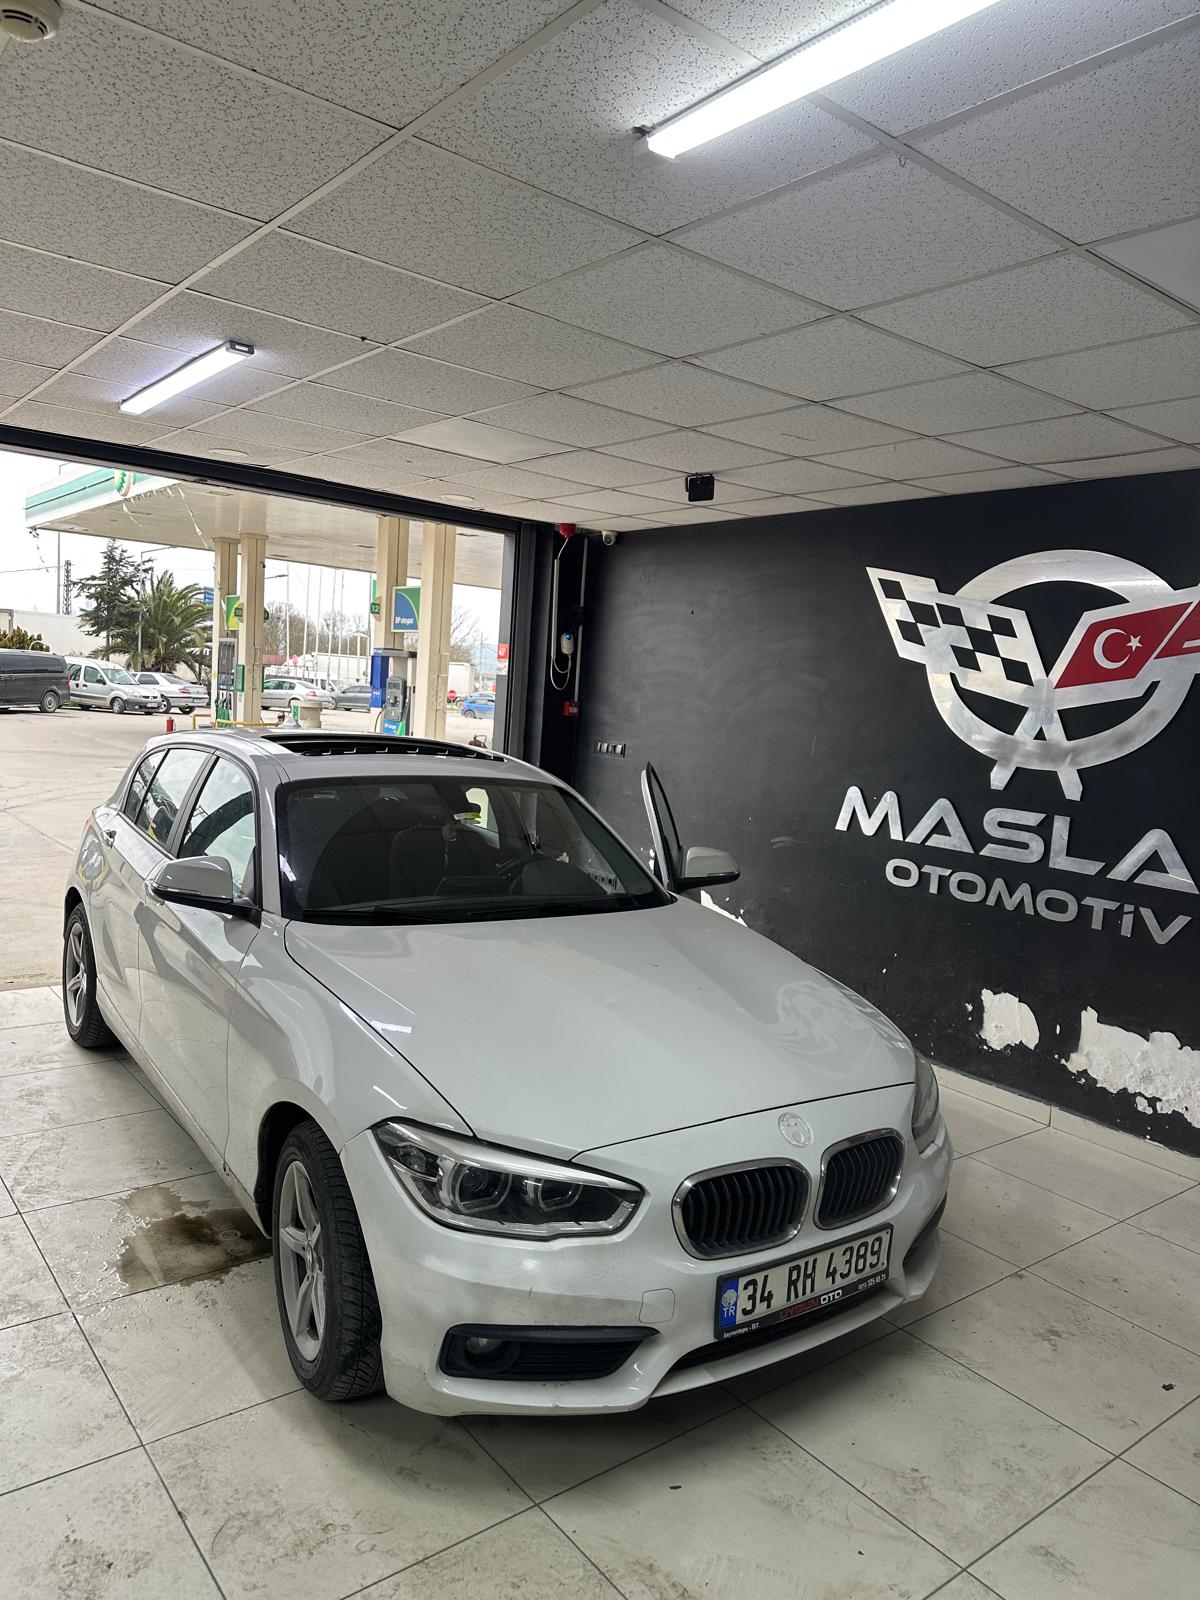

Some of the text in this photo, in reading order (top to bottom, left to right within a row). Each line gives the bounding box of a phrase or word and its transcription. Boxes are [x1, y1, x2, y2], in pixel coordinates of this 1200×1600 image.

[835, 785, 1200, 895] MASLA
[741, 1235, 883, 1317] 34 RH 4389
[820, 1289, 843, 1305] OTO
[722, 1305, 736, 1318] TR
